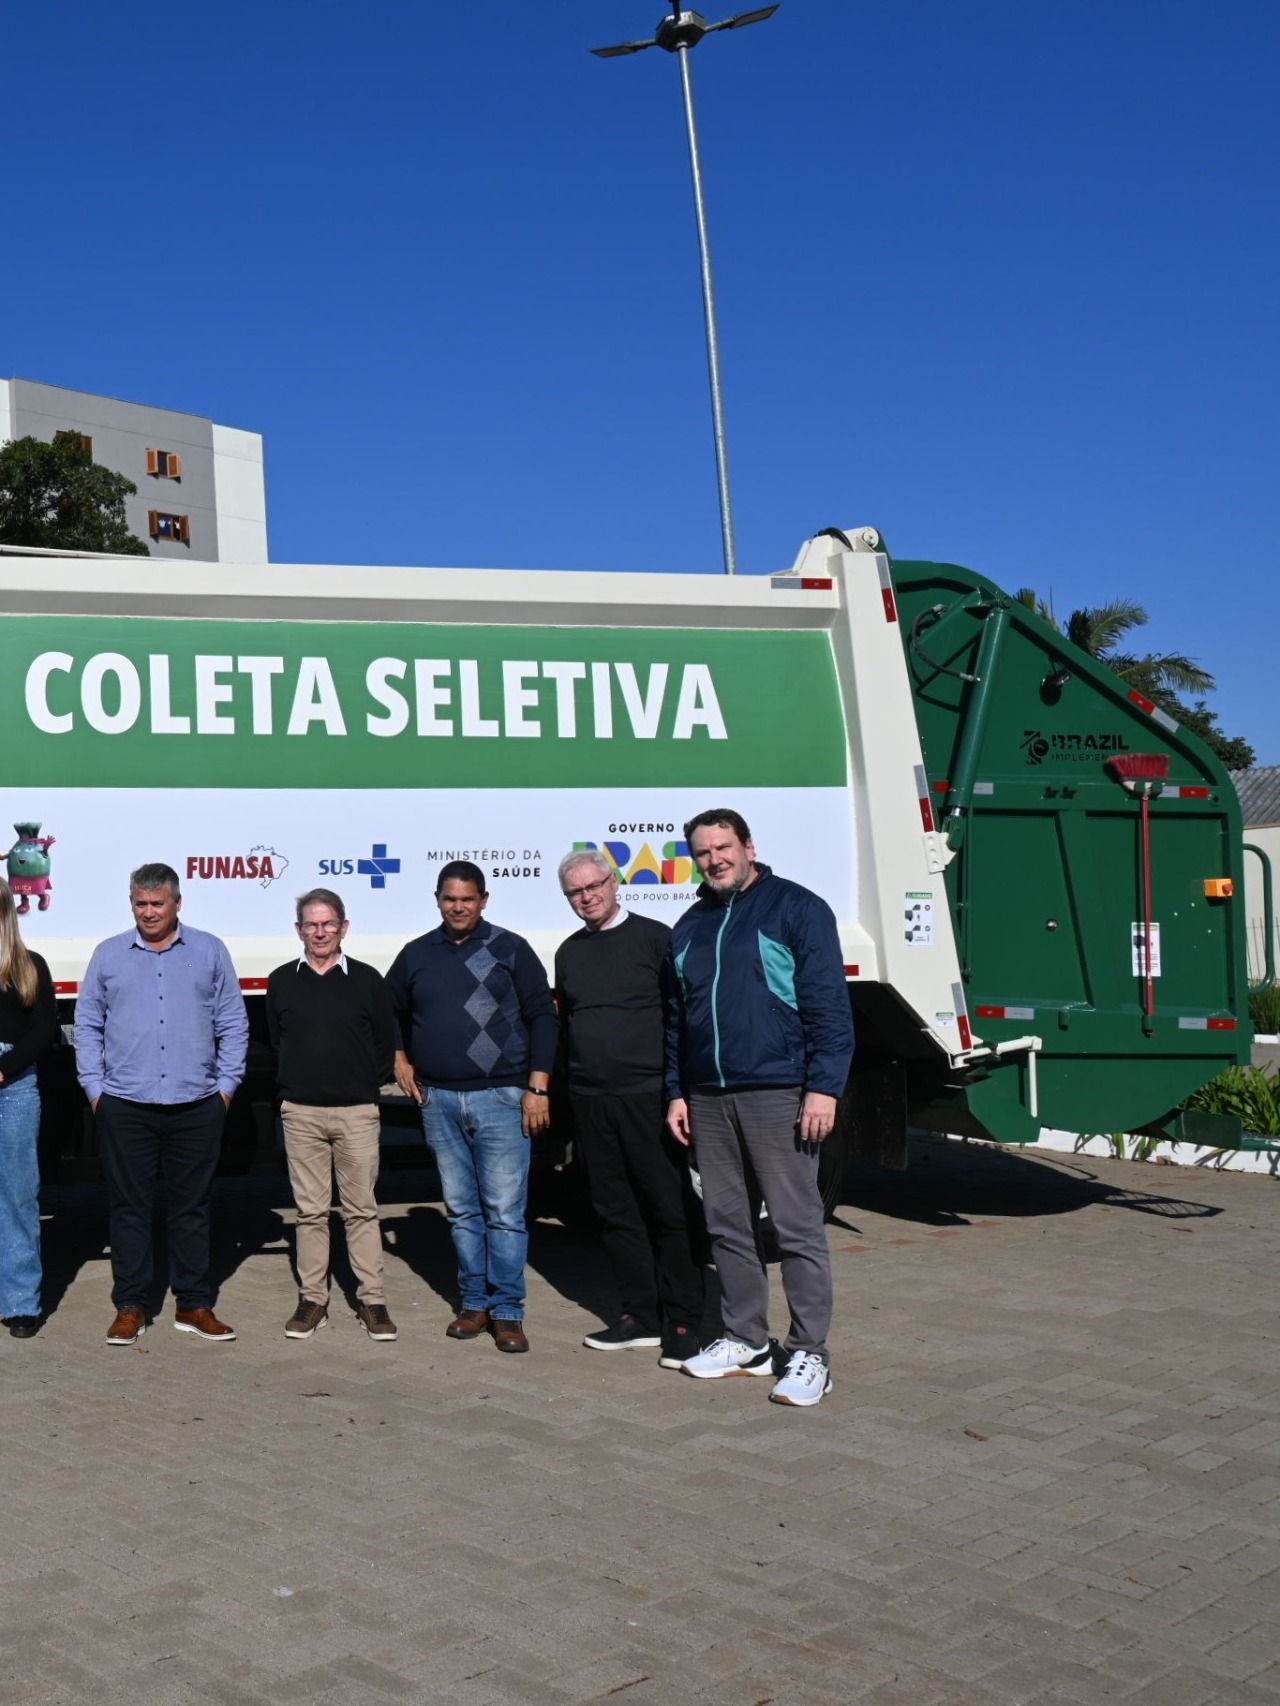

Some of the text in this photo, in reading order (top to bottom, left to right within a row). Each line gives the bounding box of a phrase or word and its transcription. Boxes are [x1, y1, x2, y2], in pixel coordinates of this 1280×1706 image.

[25, 651, 729, 741] COLETA SELETIVA
[1051, 734, 1130, 751] BRAZIL
[608, 823, 675, 833] GOVERNO
[427, 848, 542, 861] MINISTÉRIO DA
[186, 856, 274, 880] FUNASA
[318, 859, 354, 875] SUS
[492, 865, 541, 878] SAÚDE
[625, 893, 640, 901] DO
[643, 892, 669, 901] POVO
